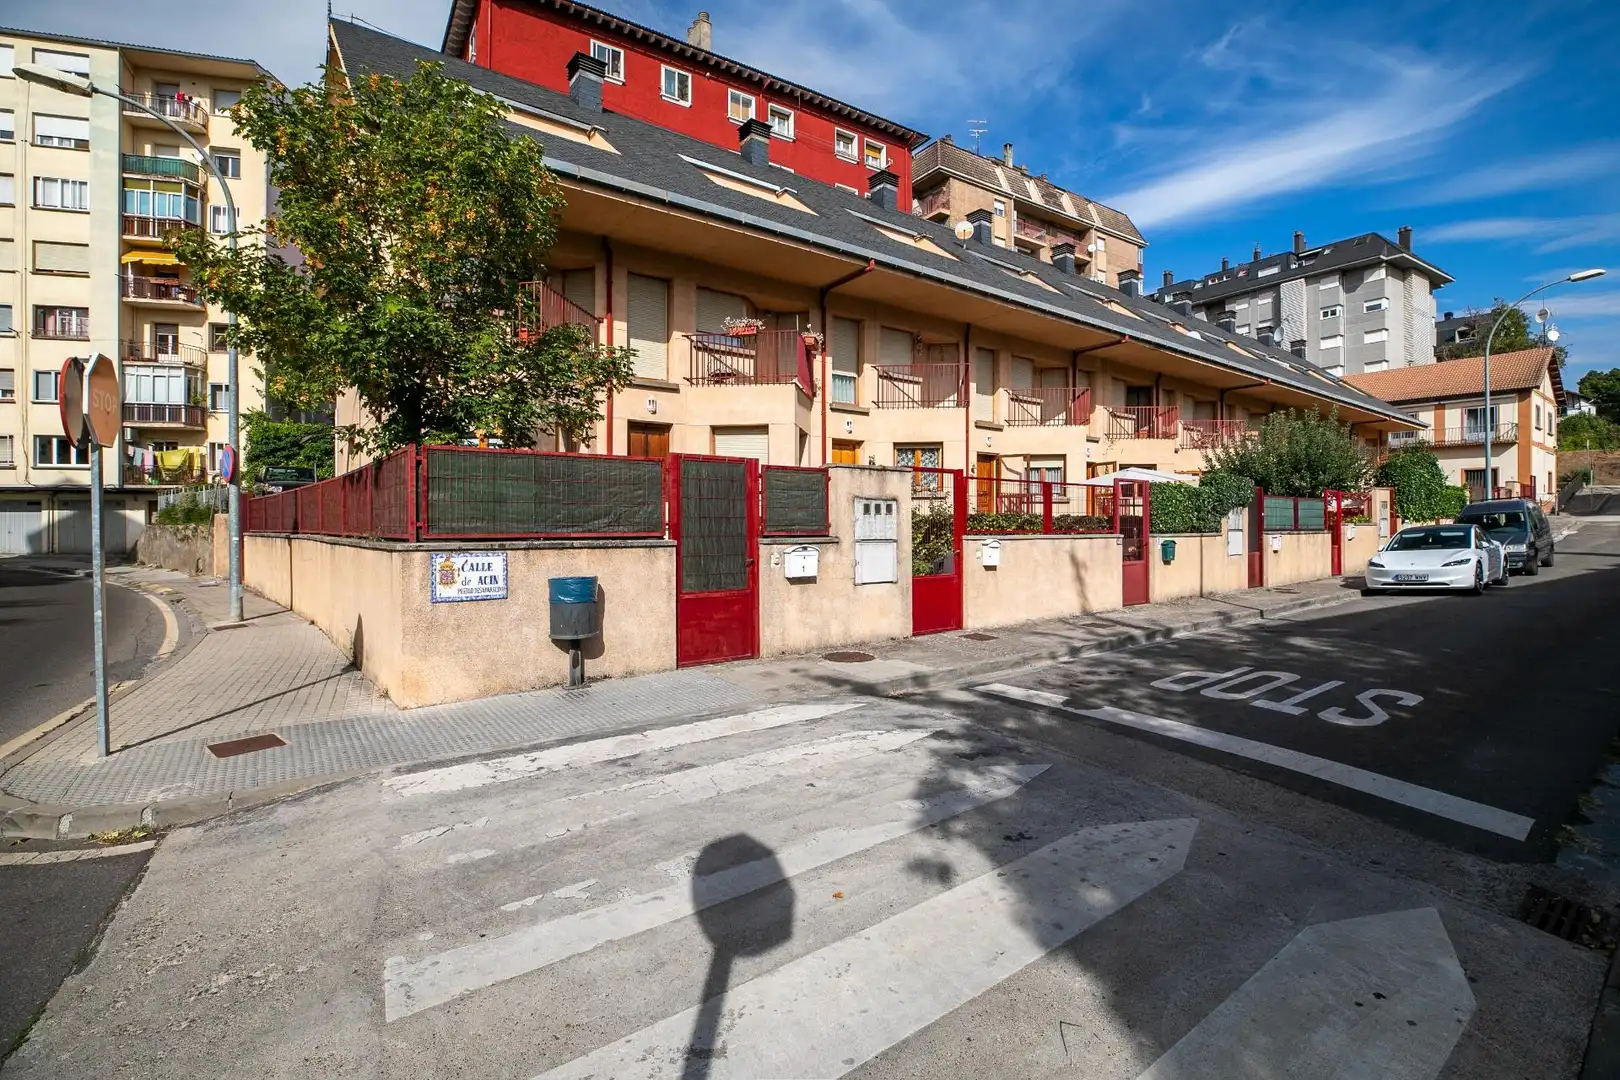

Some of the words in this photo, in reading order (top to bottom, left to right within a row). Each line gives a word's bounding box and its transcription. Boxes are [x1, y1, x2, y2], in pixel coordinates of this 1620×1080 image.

[92, 389, 118, 413] STOP
[461, 559, 493, 572] CALLE
[461, 576, 472, 587] de
[1150, 666, 1425, 727] STOP
